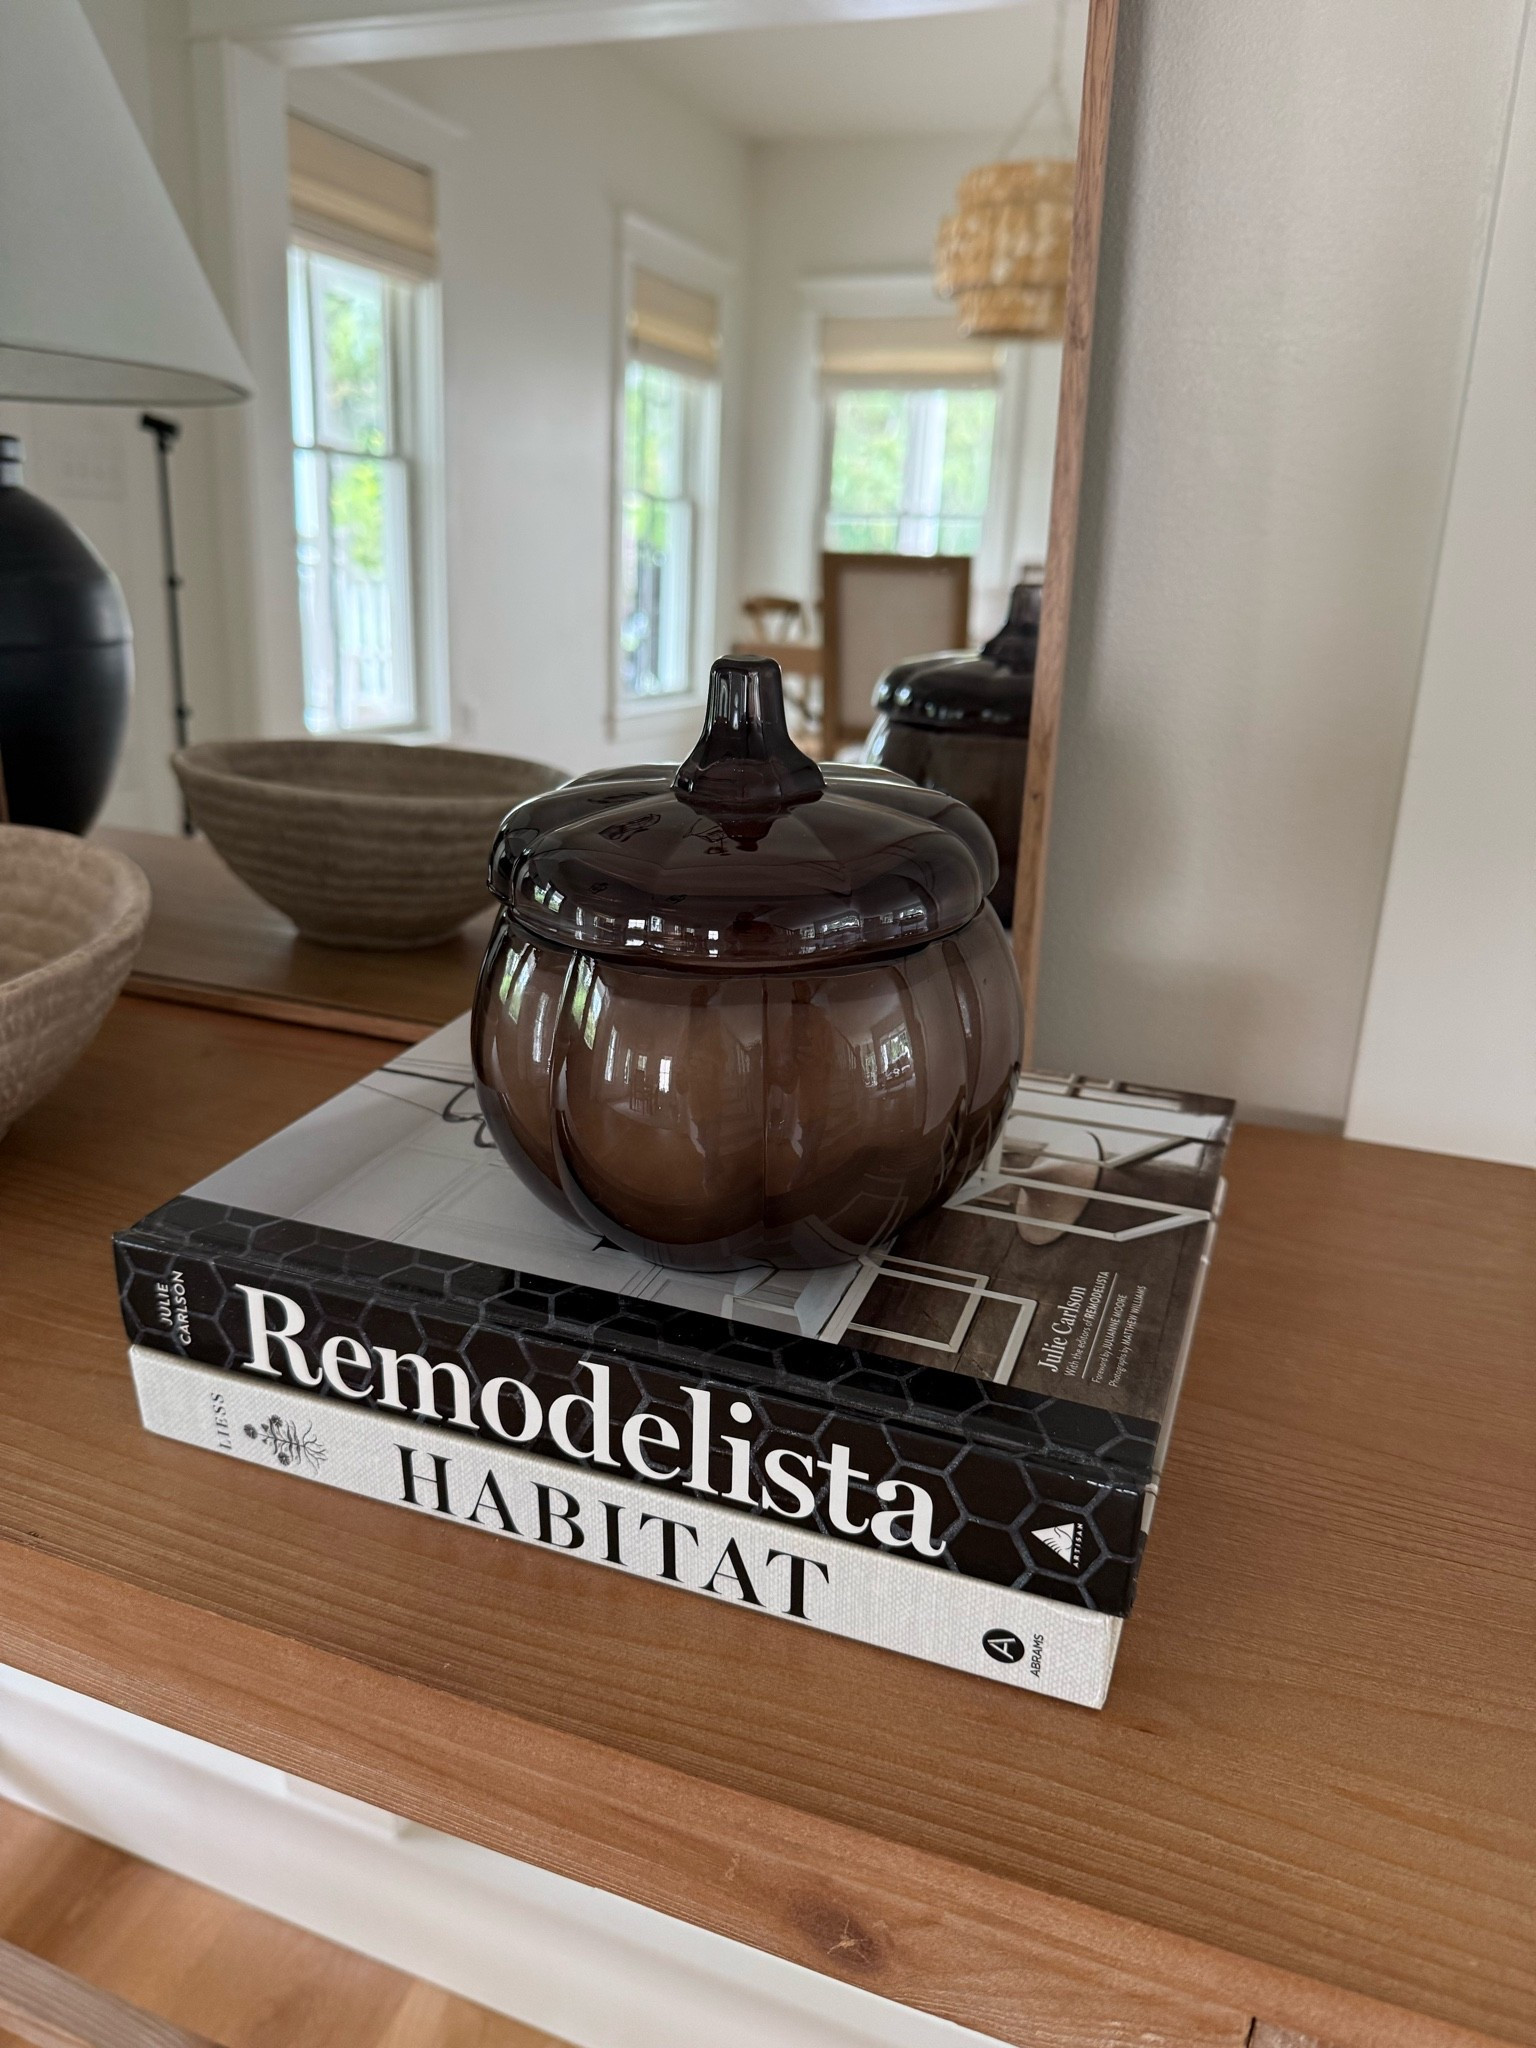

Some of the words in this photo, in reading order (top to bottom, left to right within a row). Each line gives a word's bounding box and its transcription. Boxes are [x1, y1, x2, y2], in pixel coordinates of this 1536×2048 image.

[156, 1282, 173, 1326] JULIE
[172, 1270, 192, 1345] CARLSON
[1051, 1286, 1087, 1335] Carlson
[1084, 1271, 1110, 1320] REMODELISTA
[1113, 1294, 1128, 1318] MOORE
[1130, 1285, 1147, 1315] WILLIAMS
[1076, 1327, 1091, 1349] editors
[1082, 1318, 1092, 1327] of
[1103, 1316, 1121, 1349] JULIANNE
[1120, 1314, 1138, 1346] MATTHEW
[1037, 1337, 1068, 1373] Julie
[1071, 1348, 1084, 1360] the
[1100, 1348, 1114, 1358] by
[1119, 1342, 1133, 1355] by
[1064, 1360, 1079, 1377] With
[1091, 1356, 1109, 1384] Foreword
[1108, 1352, 1128, 1388] Photographs
[211, 1392, 233, 1450] LIESS
[233, 1283, 947, 1558] Remodelista
[393, 1443, 830, 1621] HABITAT
[1072, 1523, 1084, 1569] ARTISAN
[1030, 1633, 1044, 1678] ABRAMS
